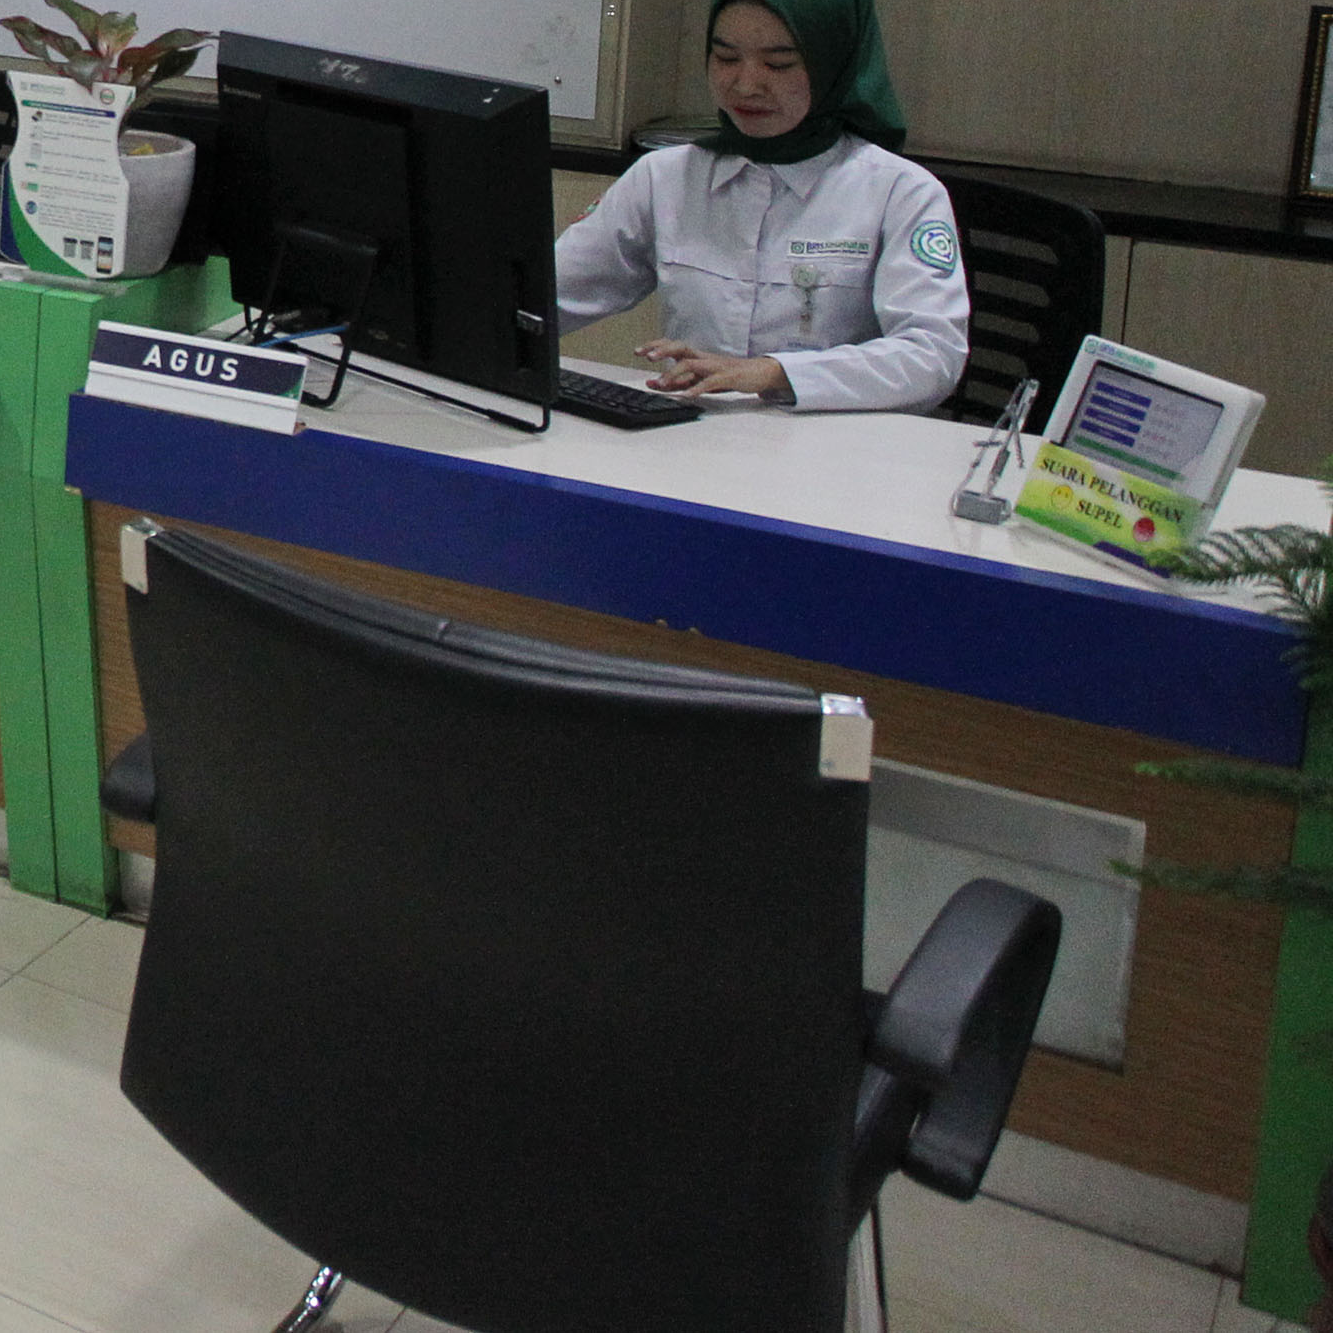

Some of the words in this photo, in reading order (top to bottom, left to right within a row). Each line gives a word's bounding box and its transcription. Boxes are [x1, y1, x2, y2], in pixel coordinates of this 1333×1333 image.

[143, 344, 239, 381] AGUS
[1041, 457, 1085, 485] SUARA
[1089, 476, 1183, 522] PELANGGAN
[1076, 499, 1122, 529] SUPEL
